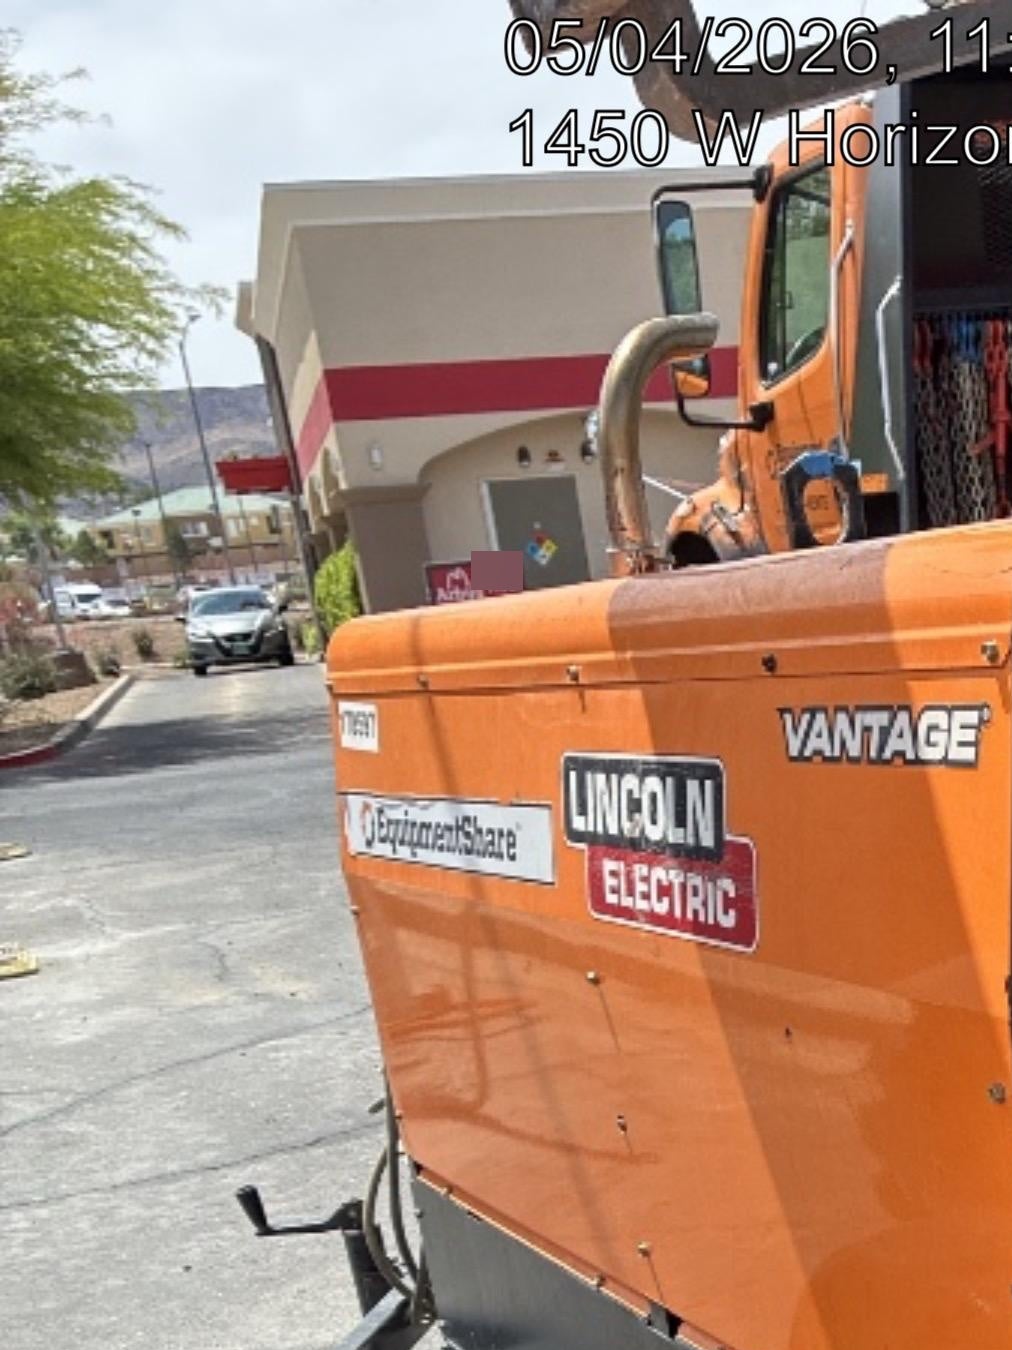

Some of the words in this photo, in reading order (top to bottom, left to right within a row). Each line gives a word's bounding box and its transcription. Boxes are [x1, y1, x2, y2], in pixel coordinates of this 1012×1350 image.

[779, 706, 980, 766] VANTAGE
[374, 808, 518, 862] EquipmentShare
[568, 770, 716, 848] LINCOLN
[602, 858, 738, 930] ELECTRIC
